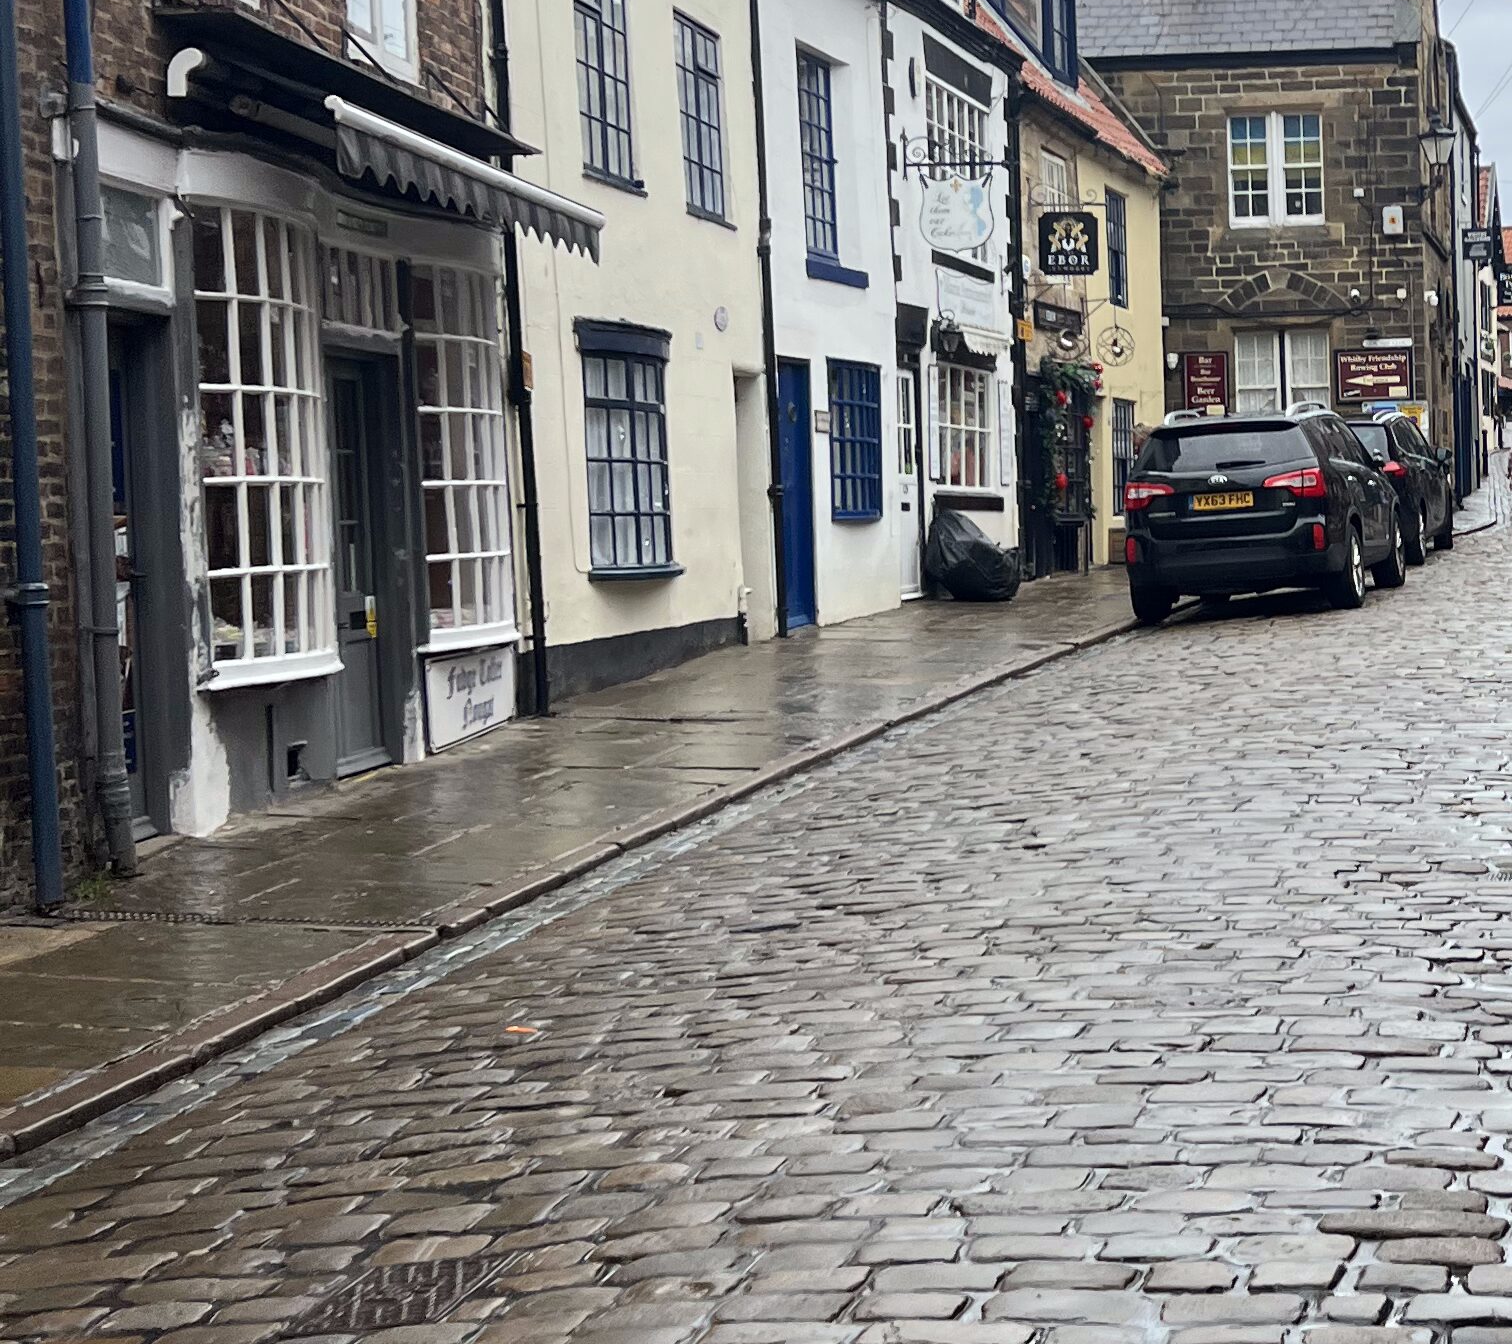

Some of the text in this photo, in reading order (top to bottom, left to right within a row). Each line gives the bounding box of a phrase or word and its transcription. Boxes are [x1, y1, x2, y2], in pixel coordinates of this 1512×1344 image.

[1047, 254, 1090, 266] EBOR
[1341, 354, 1406, 364] Whitby Friendship
[1350, 362, 1397, 372] Rowing Club
[1197, 387, 1215, 395] Beer
[1191, 396, 1221, 404] Garden
[1196, 492, 1251, 507] YX63 FHC
